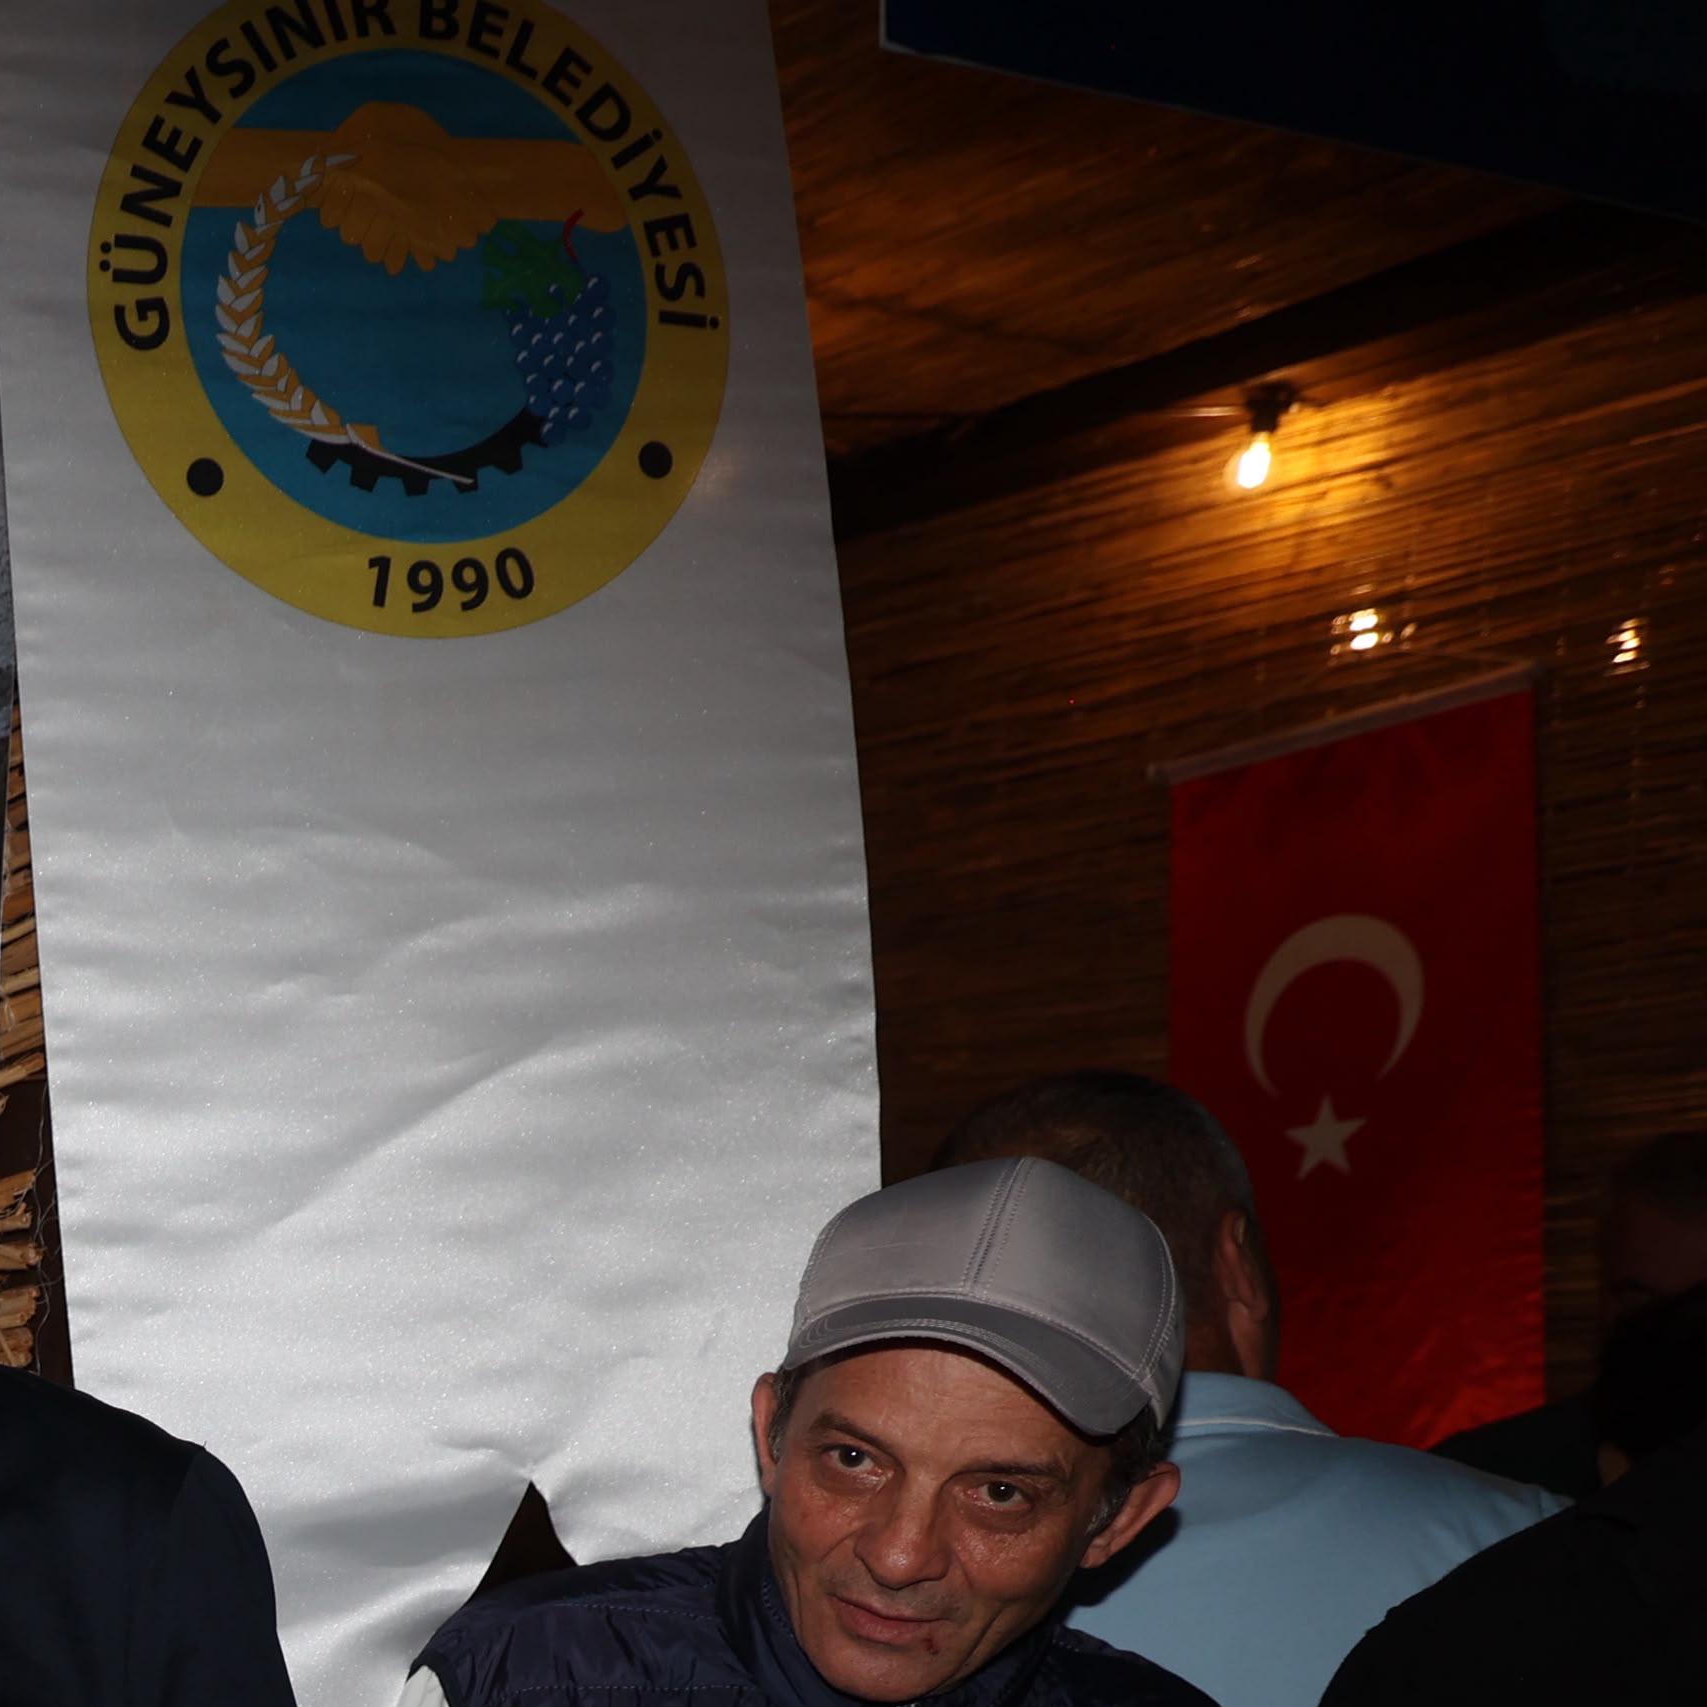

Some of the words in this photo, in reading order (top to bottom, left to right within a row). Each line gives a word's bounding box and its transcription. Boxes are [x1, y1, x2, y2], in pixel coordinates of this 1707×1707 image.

[100, 0, 397, 351] GÜNEYSINIR
[418, 0, 719, 330] BELEDİYESİ
[367, 547, 535, 613] 1990
